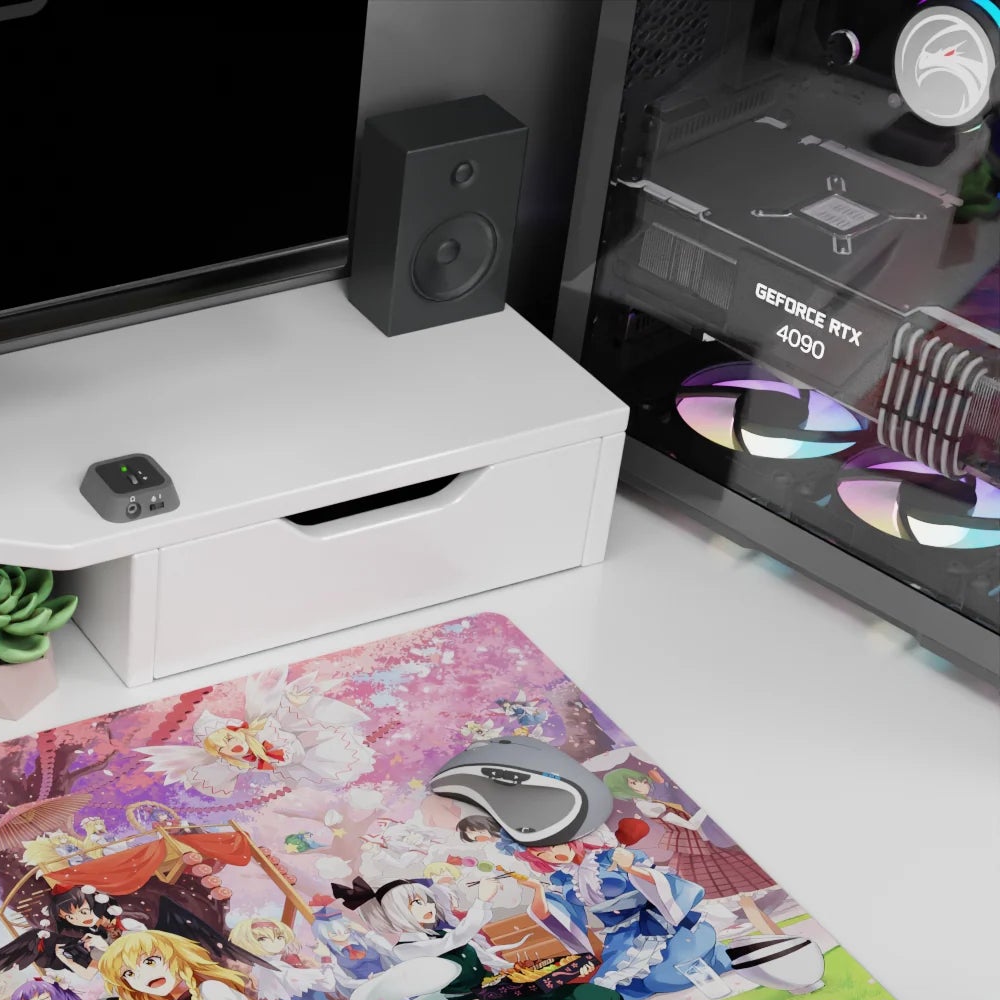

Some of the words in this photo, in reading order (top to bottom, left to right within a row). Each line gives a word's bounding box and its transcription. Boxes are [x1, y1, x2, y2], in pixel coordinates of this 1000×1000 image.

[755, 282, 827, 329] GEFORCE
[828, 317, 863, 347] RTX
[776, 324, 825, 360] 4090
